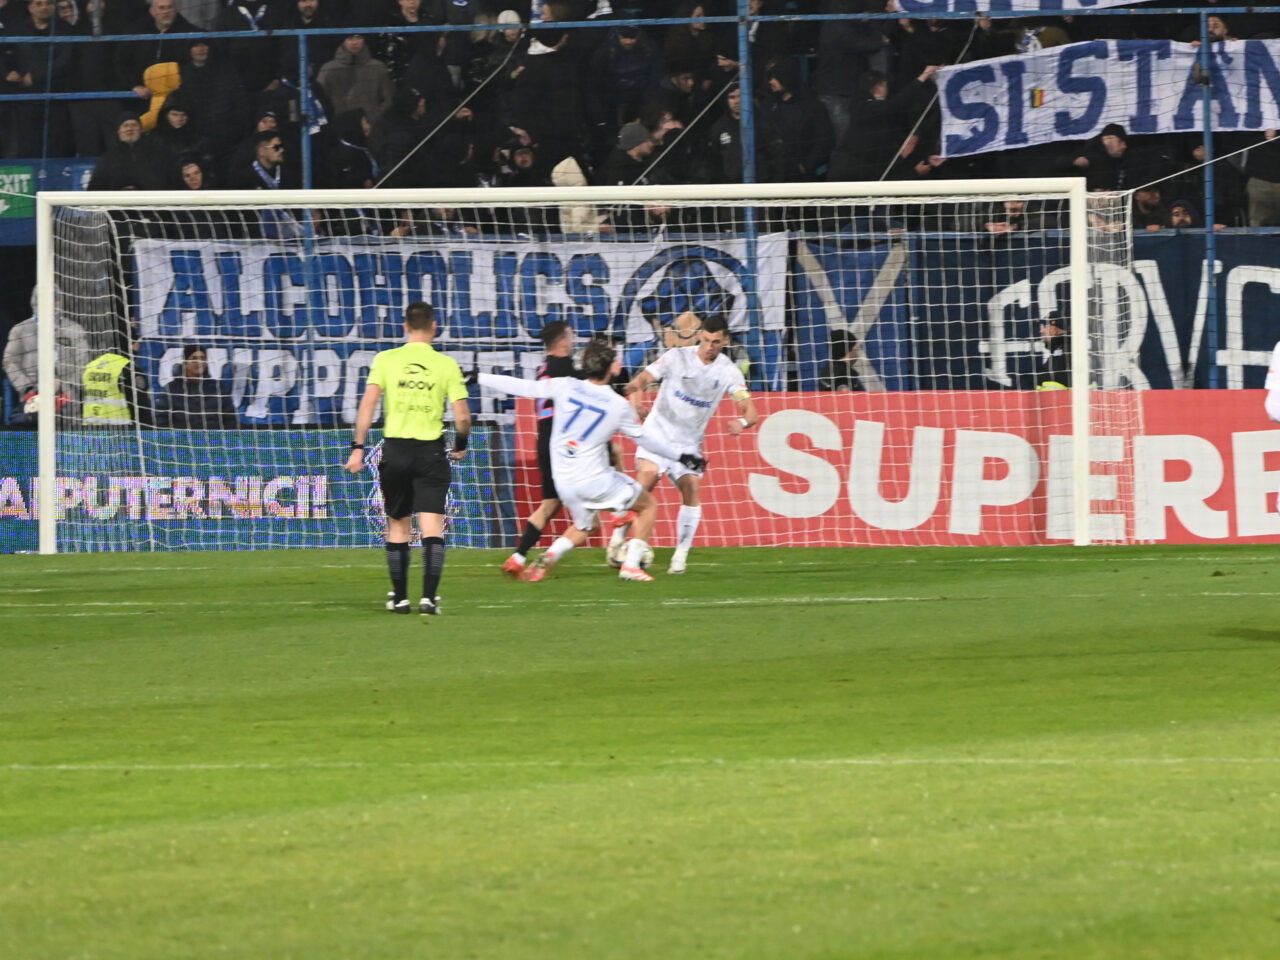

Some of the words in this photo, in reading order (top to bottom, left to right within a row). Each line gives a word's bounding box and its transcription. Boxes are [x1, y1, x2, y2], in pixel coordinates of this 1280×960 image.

[158, 249, 612, 339] ALCOHOLICS
[397, 380, 436, 391] MOOV
[561, 397, 608, 442] 77
